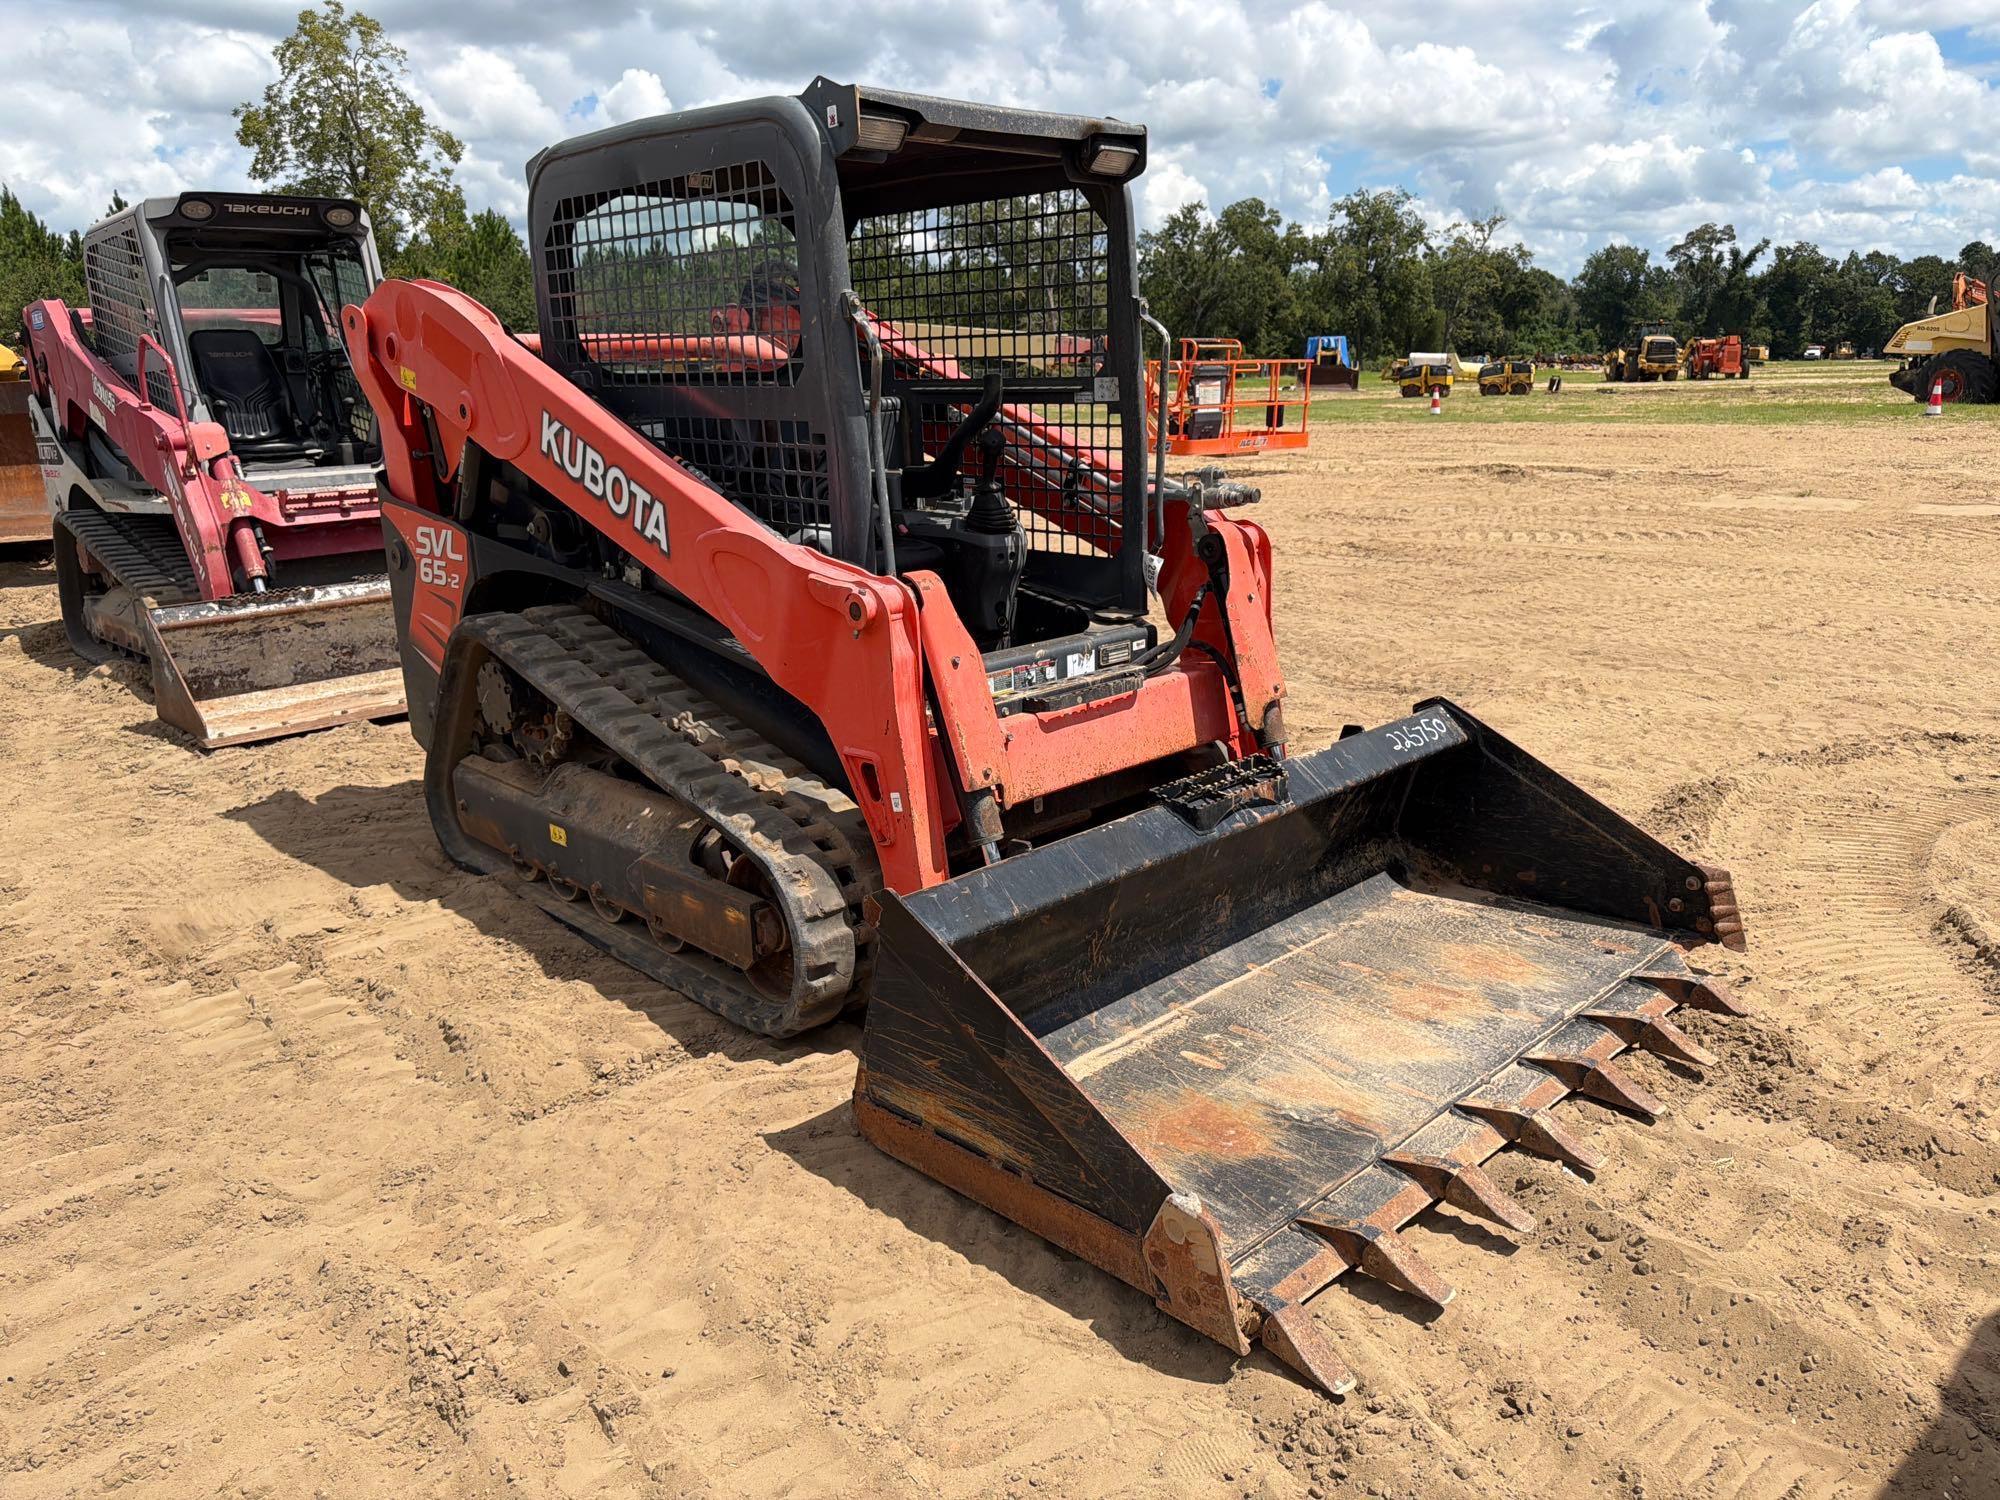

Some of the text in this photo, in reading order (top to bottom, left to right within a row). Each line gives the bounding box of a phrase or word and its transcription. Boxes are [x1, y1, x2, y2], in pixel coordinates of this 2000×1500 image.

[223, 203, 311, 216] TAKEUCHI
[541, 411, 669, 553] KUBOTA
[415, 526, 463, 561] SVL
